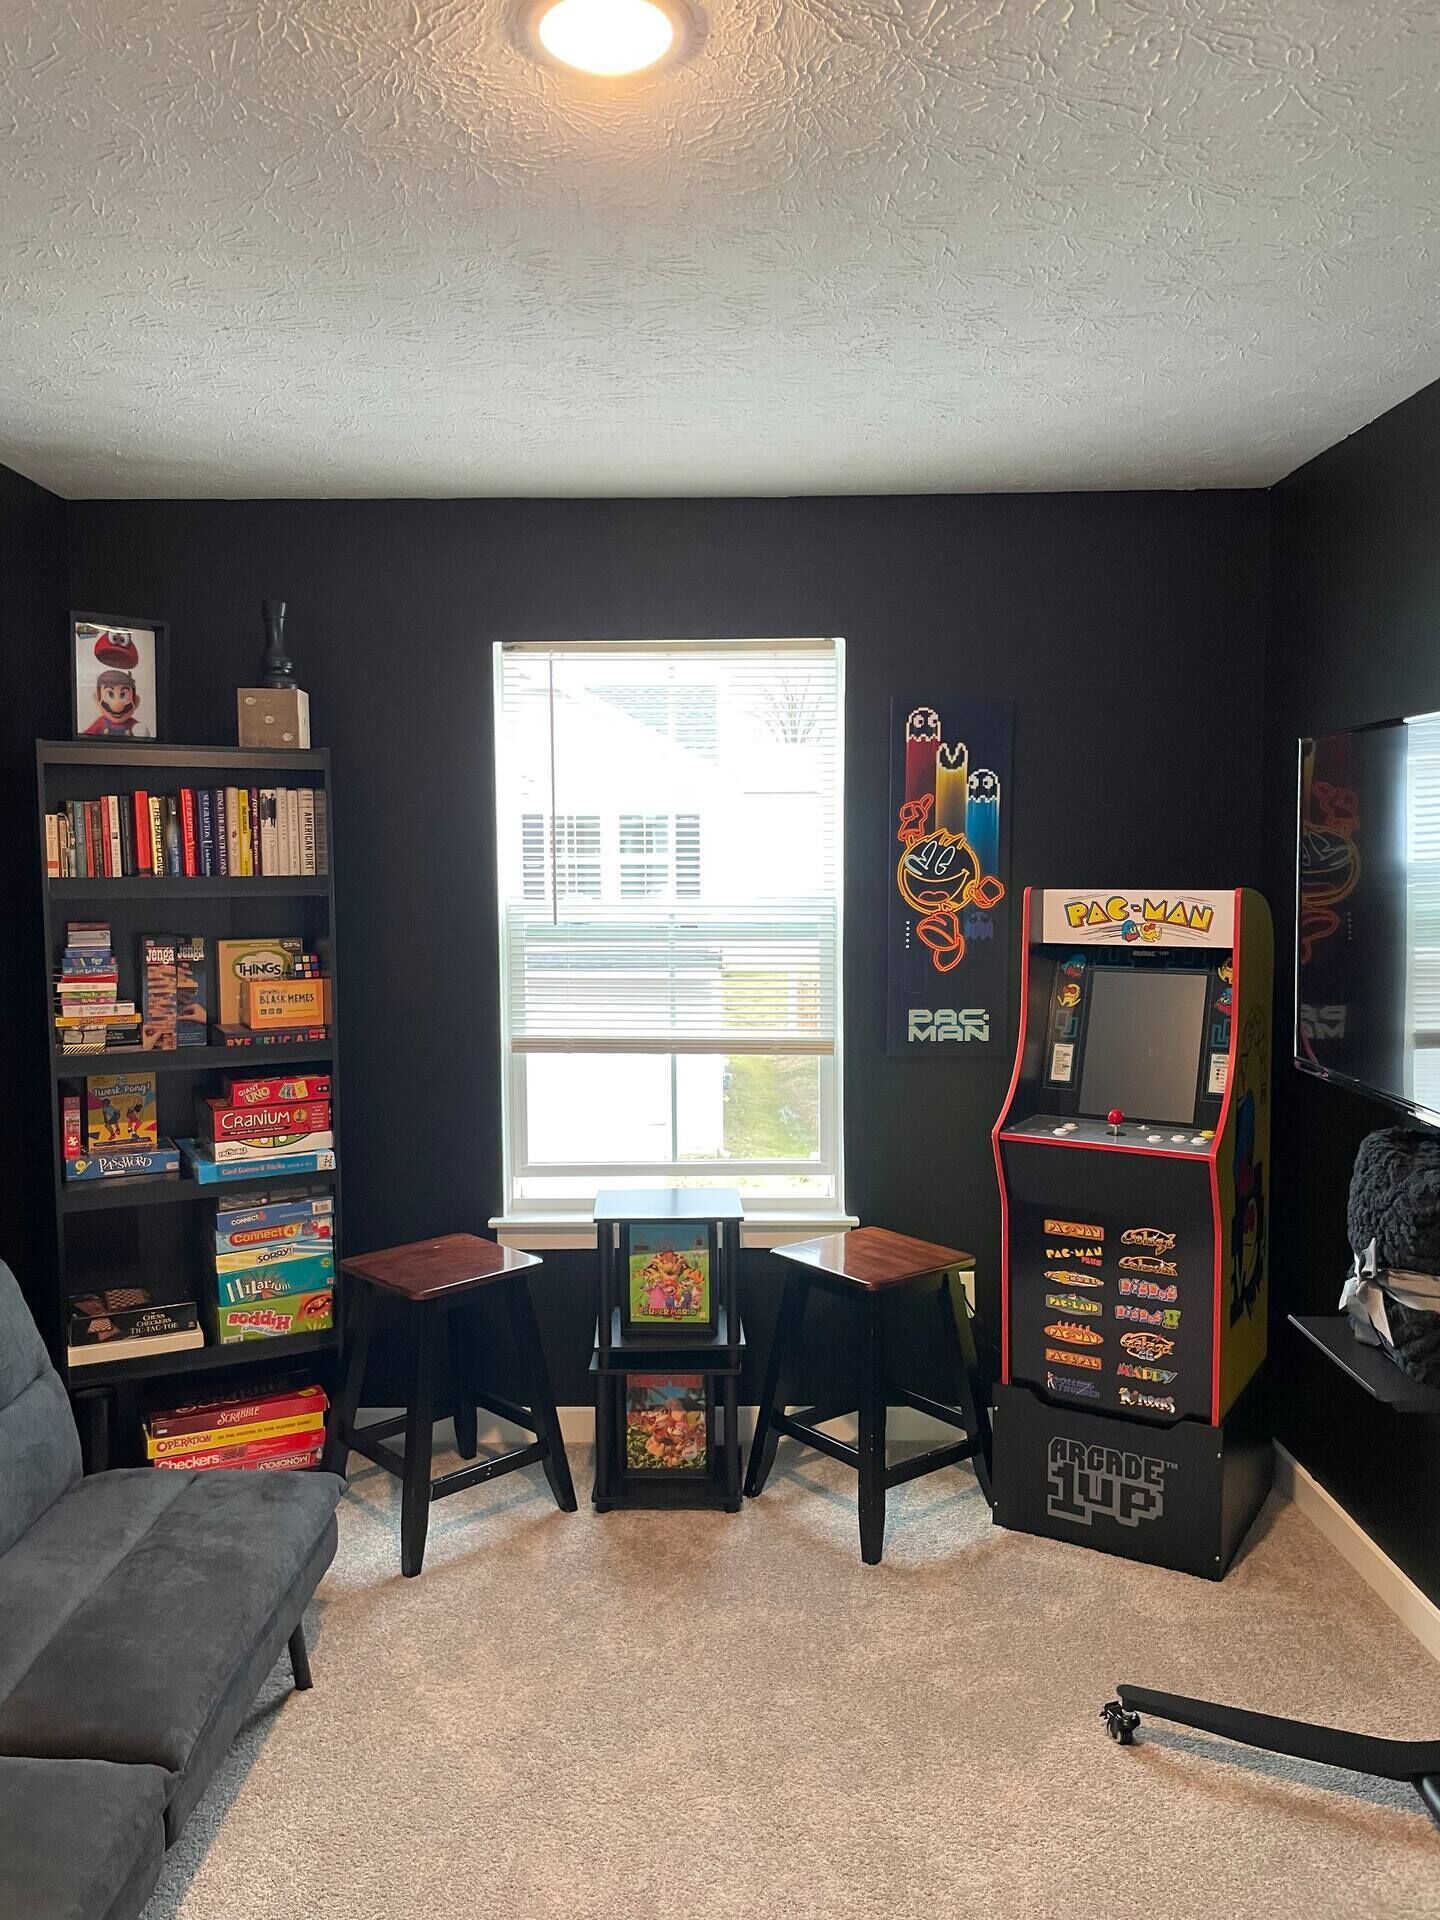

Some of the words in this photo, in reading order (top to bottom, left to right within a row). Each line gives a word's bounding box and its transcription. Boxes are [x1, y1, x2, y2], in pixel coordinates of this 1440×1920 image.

[153, 807, 161, 822] THE
[304, 812, 314, 851] AMERICAN
[305, 854, 314, 870] DIRT
[1064, 896, 1215, 933] PAC-MAN
[146, 947, 174, 964] Jenga
[177, 946, 204, 962] Jenga
[288, 994, 314, 1003] MEMES
[908, 1024, 990, 1042] MAN
[93, 1086, 122, 1097] Twerk
[238, 1084, 259, 1097] GIANT
[244, 1087, 270, 1104] UNO
[231, 1214, 259, 1226] CONNECT
[1046, 1222, 1102, 1239] PAC-MAN
[256, 1246, 294, 1264] SORRY!
[1046, 1246, 1103, 1260] PAC-MAN
[1049, 1296, 1098, 1312] PAC-LAND
[1049, 1328, 1098, 1344] PAC-MAN
[216, 1406, 260, 1426] SCRABBLE
[156, 1434, 212, 1452] OPERATION
[158, 1453, 220, 1470] Checkers
[259, 1455, 308, 1471] MONOPOLY
[1048, 1436, 1164, 1488] ARCADE
[1048, 1462, 1164, 1528] 1UP
